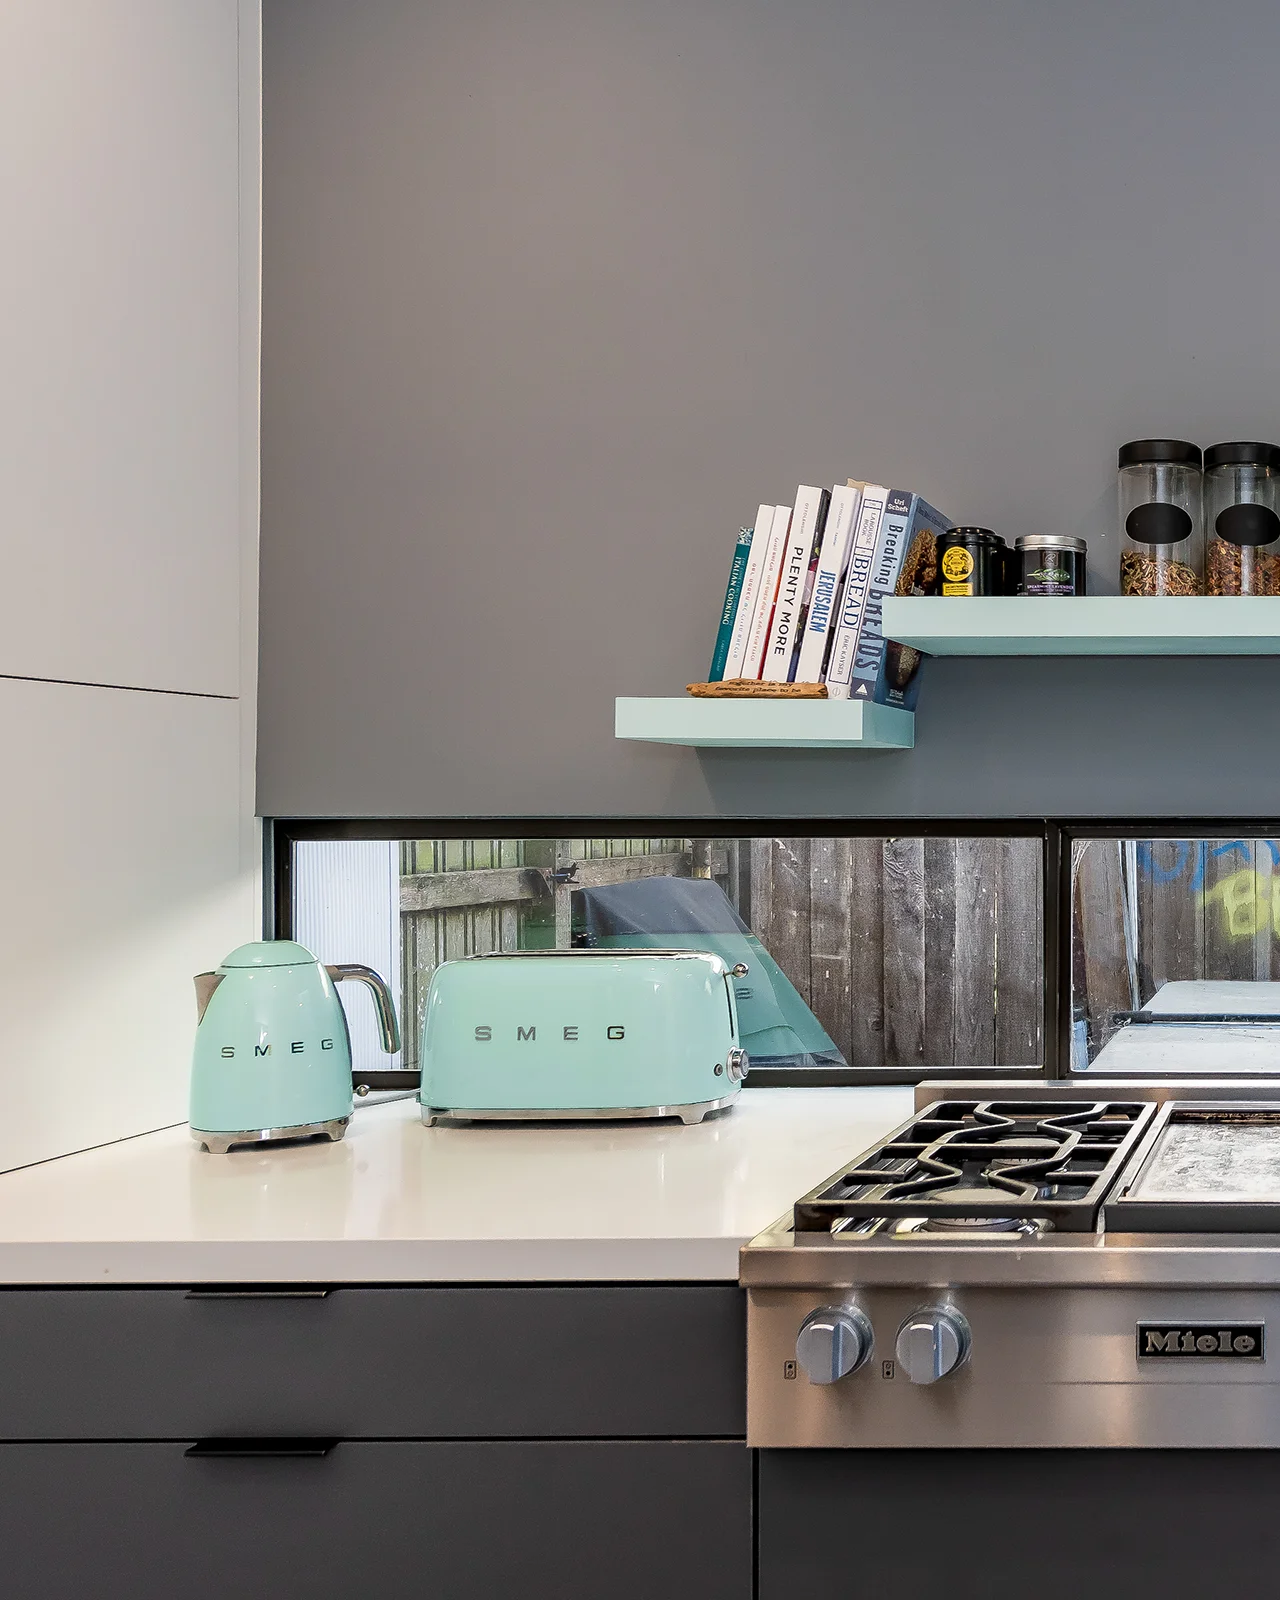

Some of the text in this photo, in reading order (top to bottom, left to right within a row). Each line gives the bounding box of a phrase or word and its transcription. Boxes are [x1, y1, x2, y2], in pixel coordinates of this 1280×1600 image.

[894, 498, 905, 506] Uri
[873, 523, 903, 586] Breaking
[722, 556, 741, 625] ITALIAN COOKING
[773, 546, 803, 656] PLENTY MORE
[808, 569, 837, 633] JERUSALEM
[841, 556, 870, 627] BREAD
[836, 650, 847, 675] KAYSER
[221, 1038, 334, 1058] SMEG
[474, 1026, 625, 1041] SMEG
[1145, 1330, 1256, 1353] Miele
